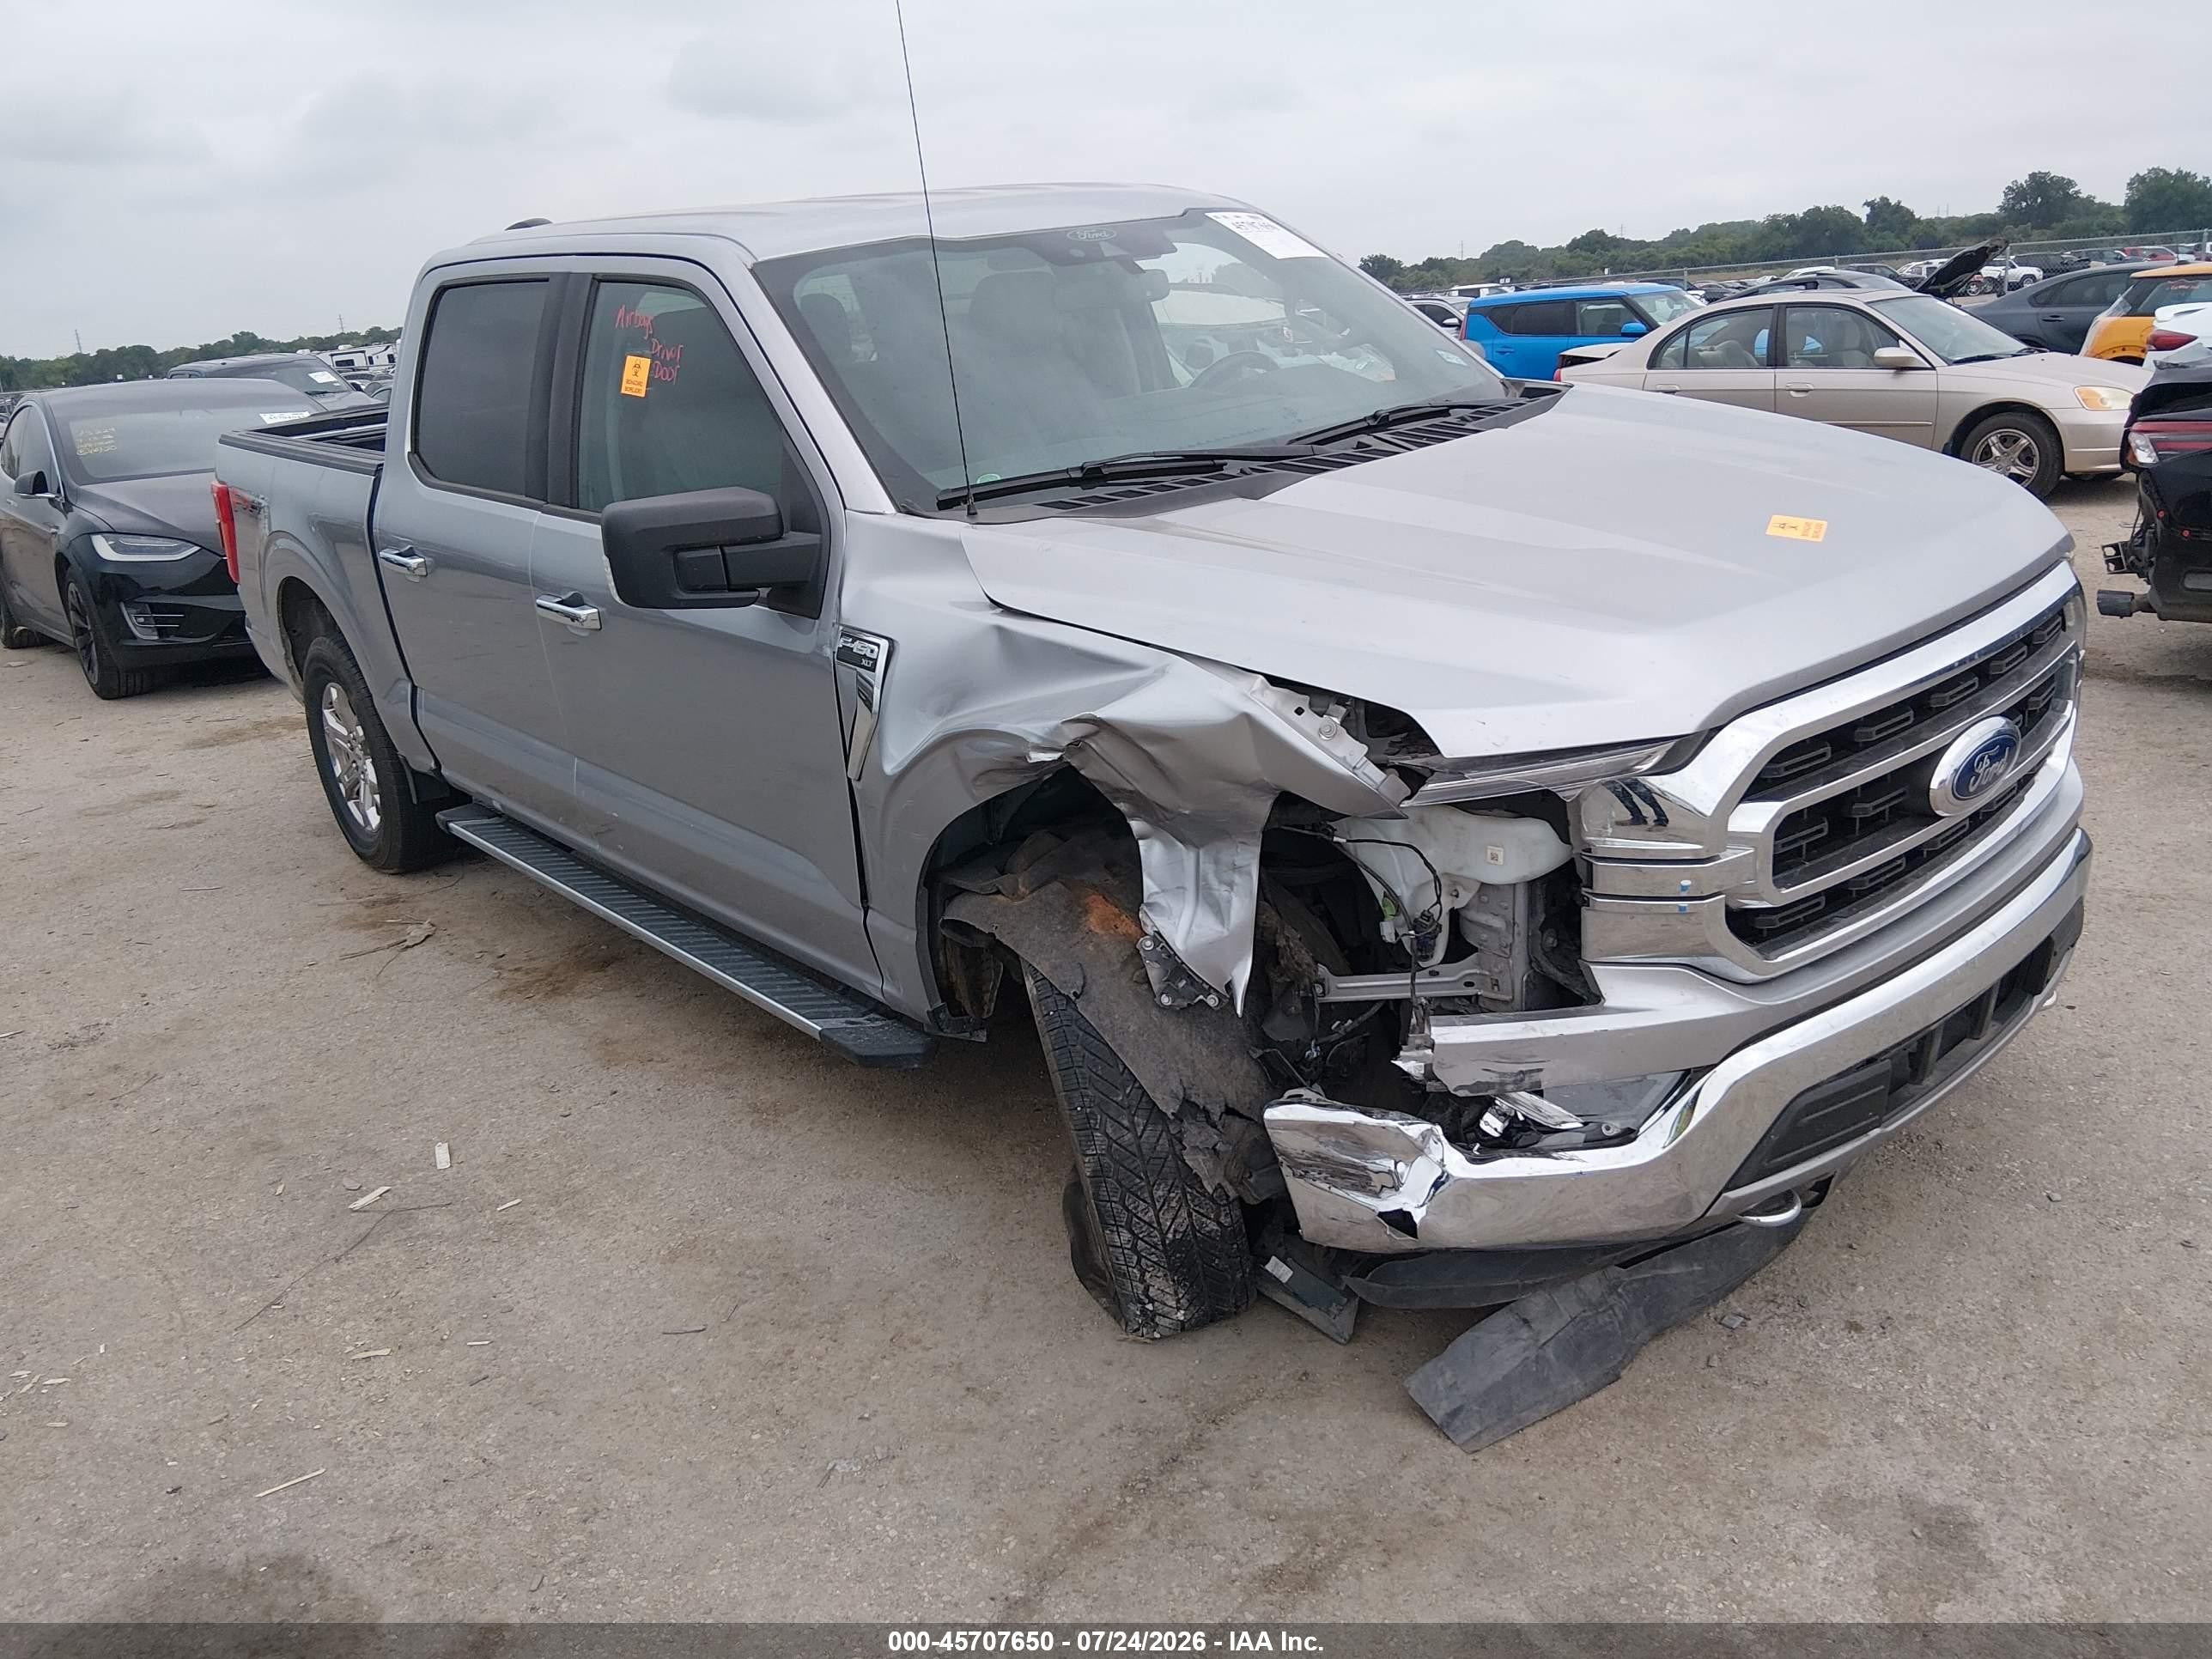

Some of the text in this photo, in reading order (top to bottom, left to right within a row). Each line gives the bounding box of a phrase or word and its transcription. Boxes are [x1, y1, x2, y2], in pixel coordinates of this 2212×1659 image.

[653, 361, 680, 386] Door
[860, 658, 873, 667] XLT
[1968, 744, 2009, 793] Ford
